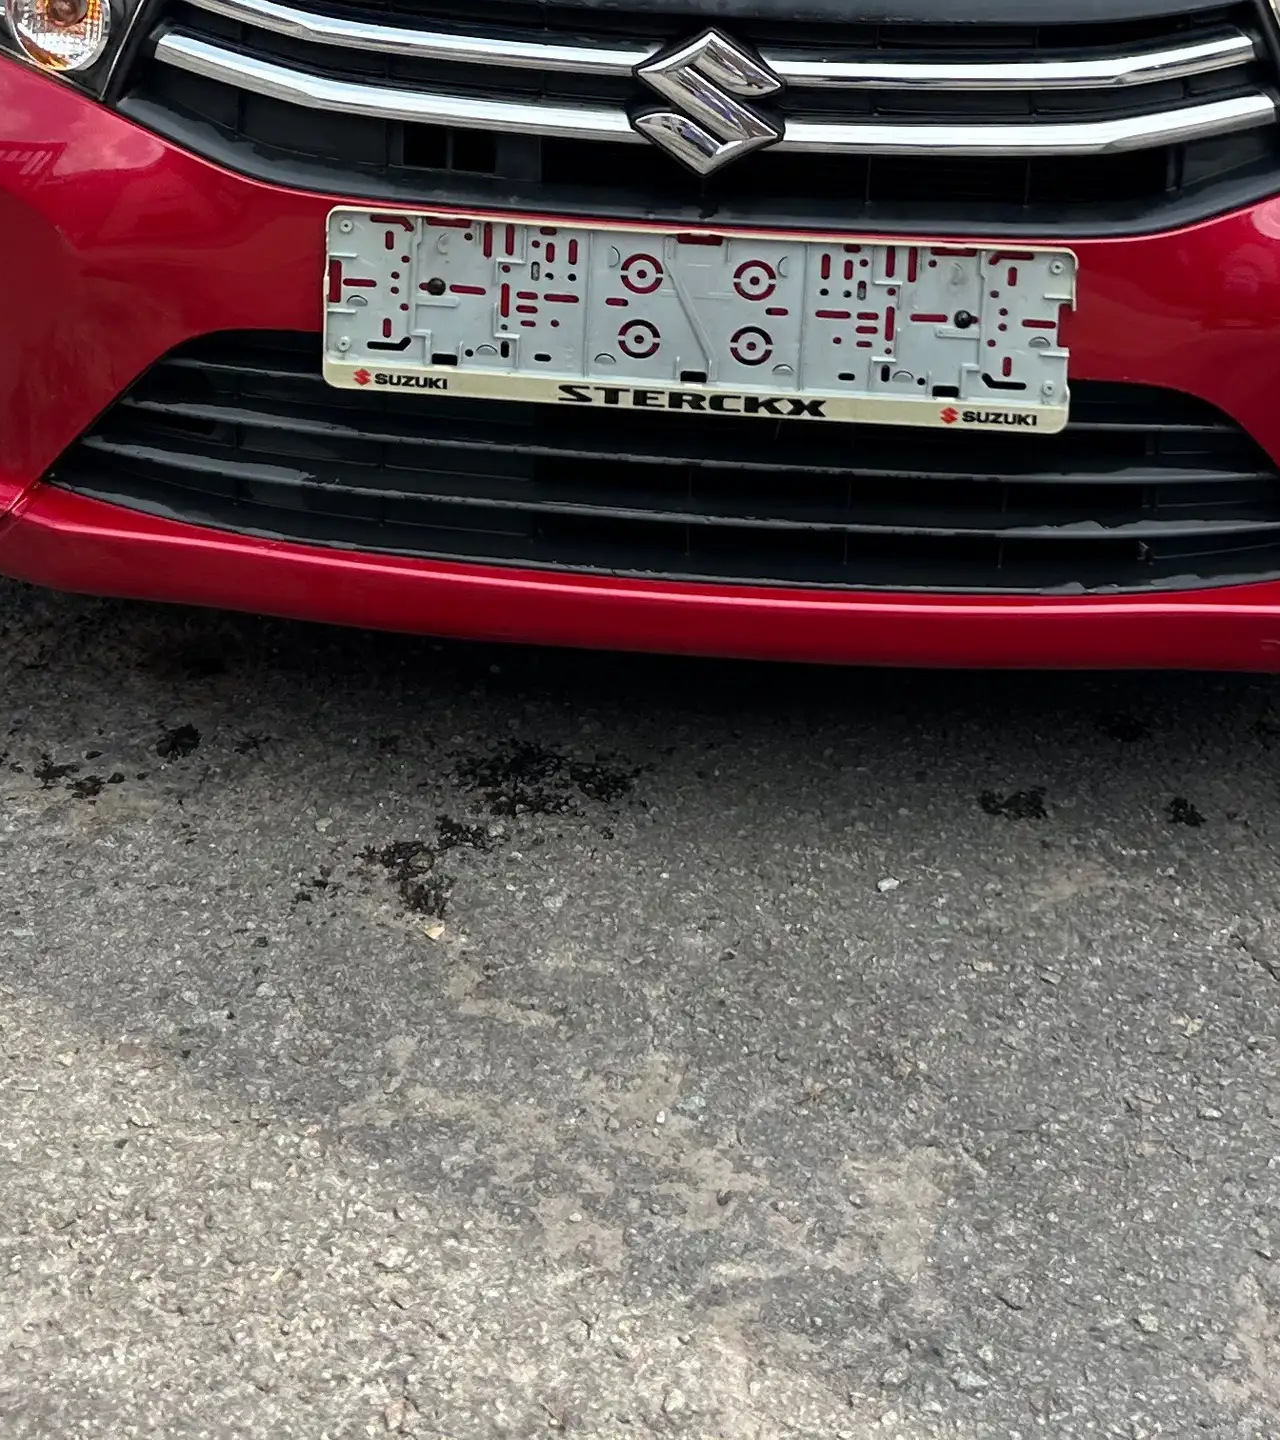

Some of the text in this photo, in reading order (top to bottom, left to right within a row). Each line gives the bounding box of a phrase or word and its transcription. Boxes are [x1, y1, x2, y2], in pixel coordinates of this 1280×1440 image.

[374, 372, 449, 390] SUZUKI
[557, 383, 827, 418] STERCKX
[961, 410, 1038, 427] SUZUKI
